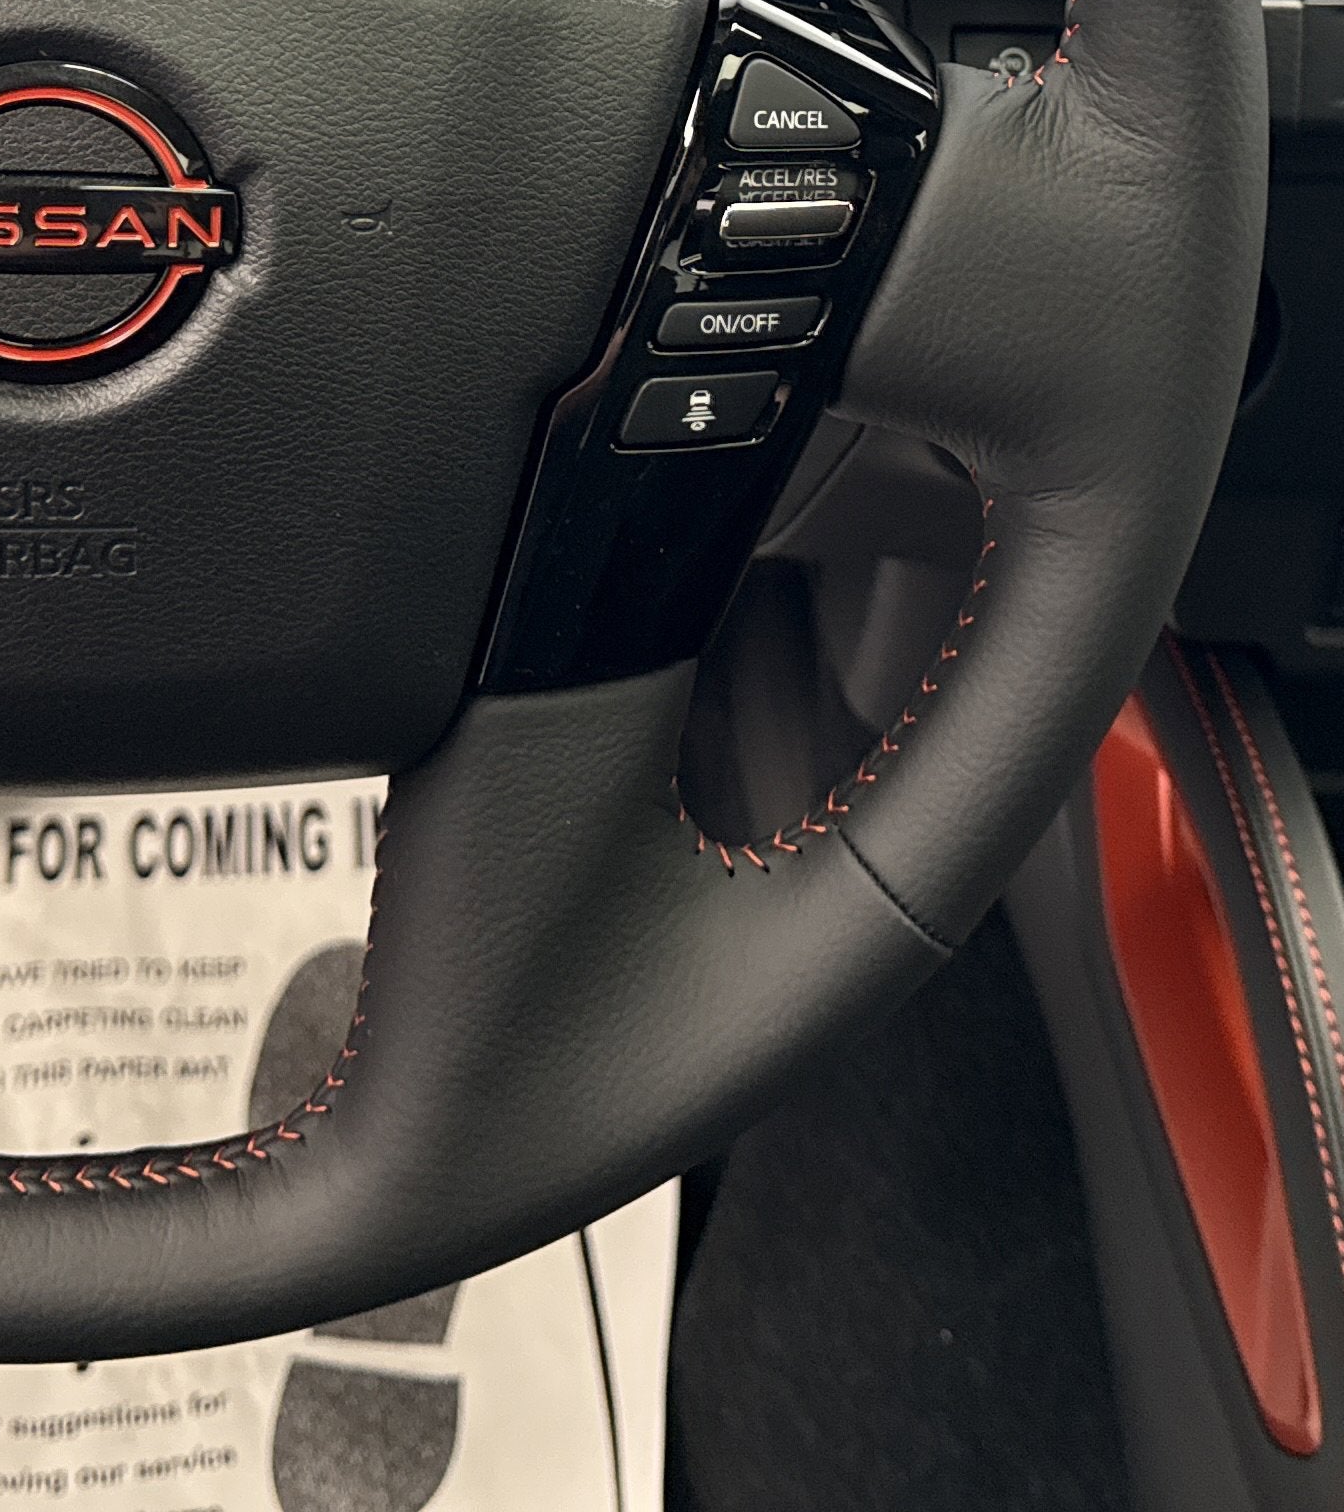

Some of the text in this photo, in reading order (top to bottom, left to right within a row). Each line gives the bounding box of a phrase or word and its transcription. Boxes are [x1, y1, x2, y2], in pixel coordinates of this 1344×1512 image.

[753, 110, 829, 130] CANCEL
[738, 168, 839, 188] ACCEL/RES
[699, 312, 781, 336] ON/OFF
[6, 808, 105, 885] FOR
[129, 798, 331, 880] COMING
